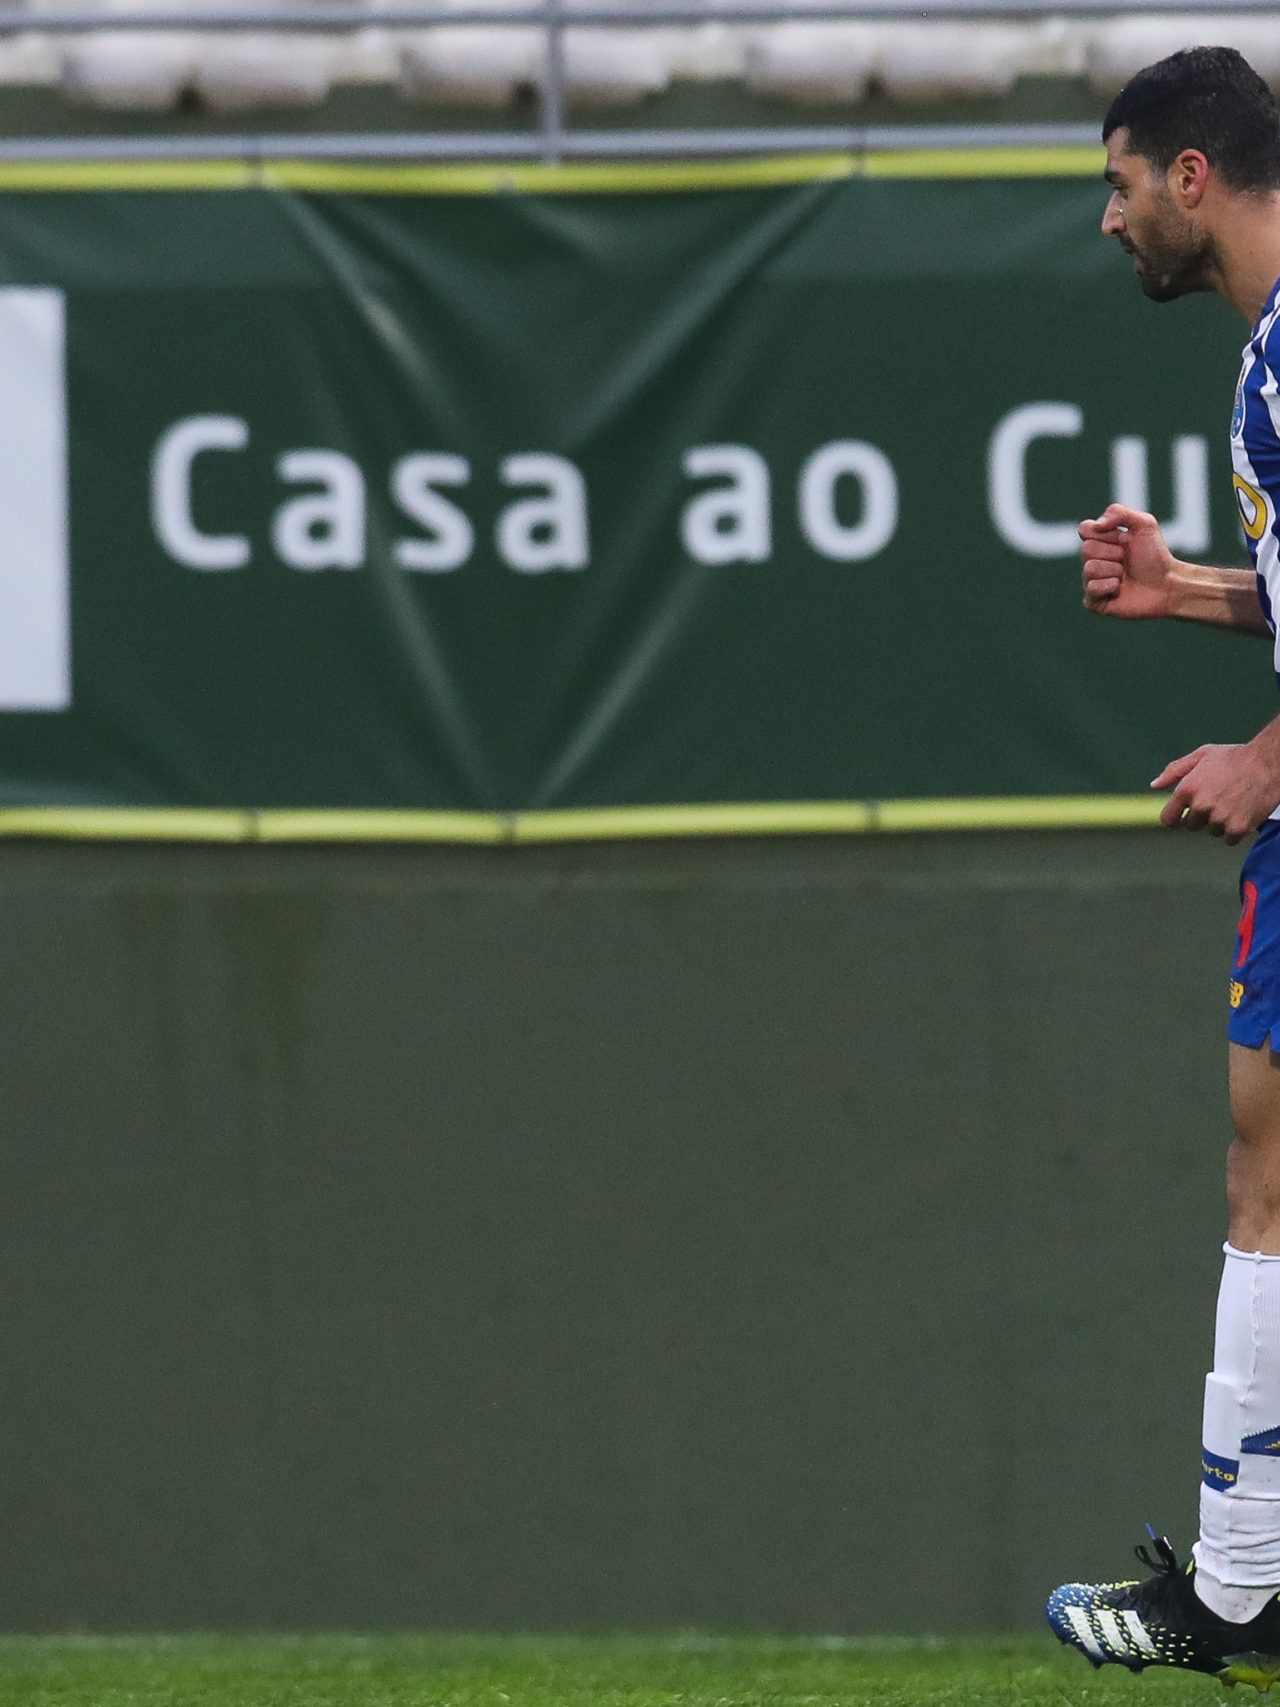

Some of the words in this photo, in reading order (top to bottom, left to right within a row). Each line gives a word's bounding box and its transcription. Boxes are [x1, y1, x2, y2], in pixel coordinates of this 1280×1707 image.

[150, 412, 590, 573] Casa
[681, 437, 899, 565] ao
[987, 400, 1247, 559] Cu
